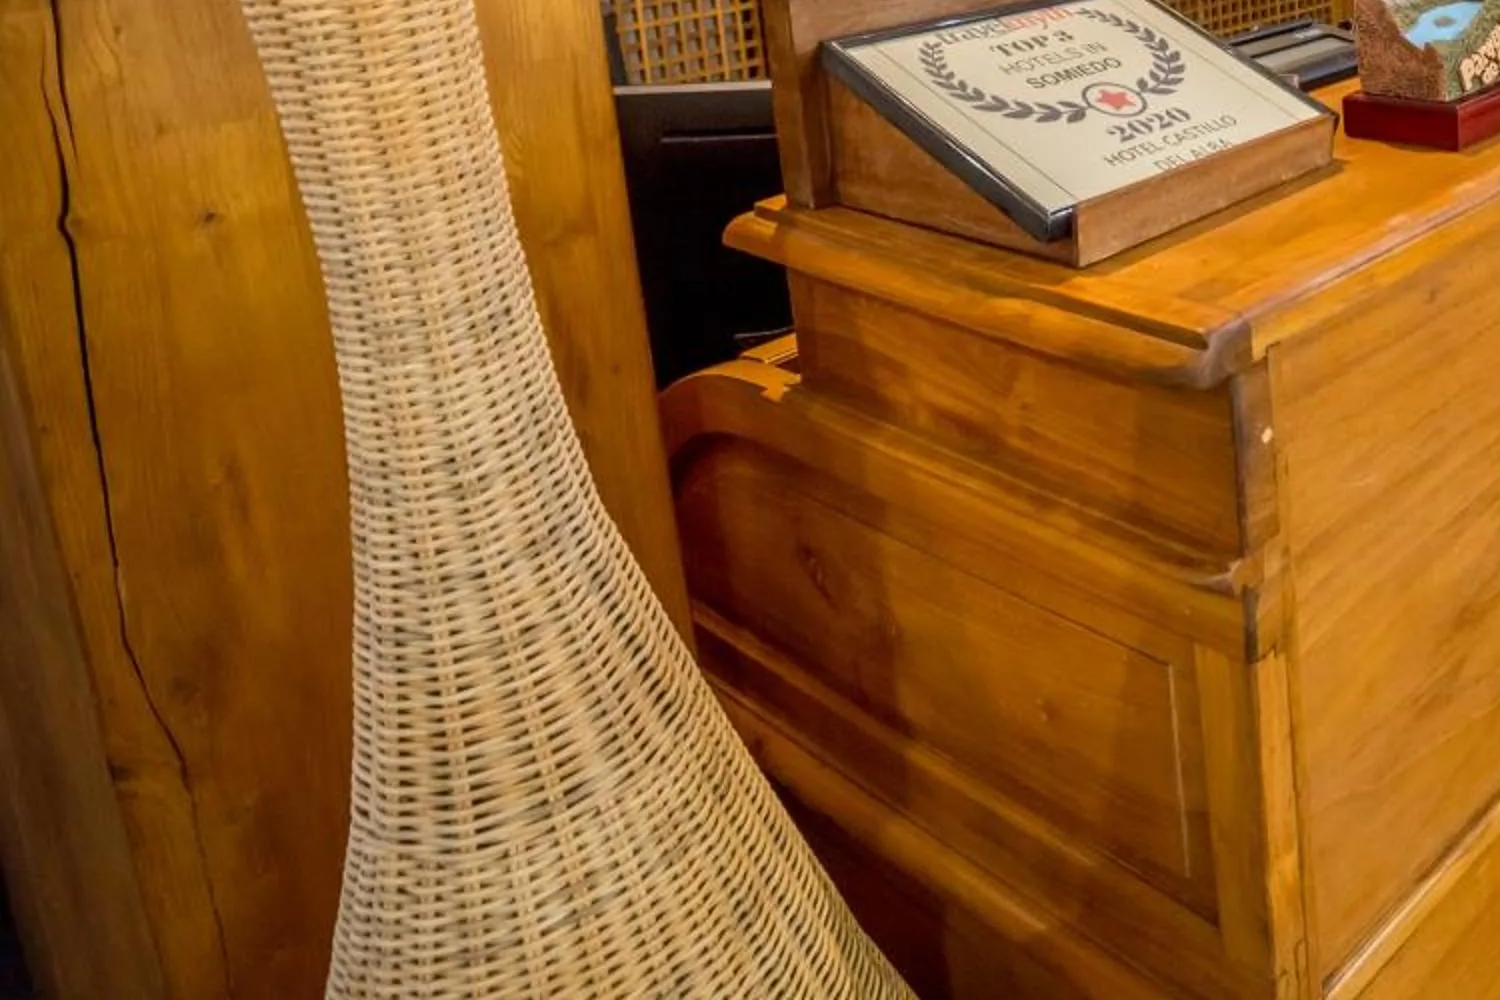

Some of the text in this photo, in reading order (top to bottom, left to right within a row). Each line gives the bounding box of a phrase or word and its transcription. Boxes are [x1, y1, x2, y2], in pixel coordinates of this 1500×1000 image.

[990, 34, 1049, 58] TOP
[998, 46, 1084, 75] HOTELS
[1025, 56, 1122, 90] SOMIEDO
[1103, 114, 1238, 167] HOTEL CASTILLO
[1105, 106, 1192, 143] 2020
